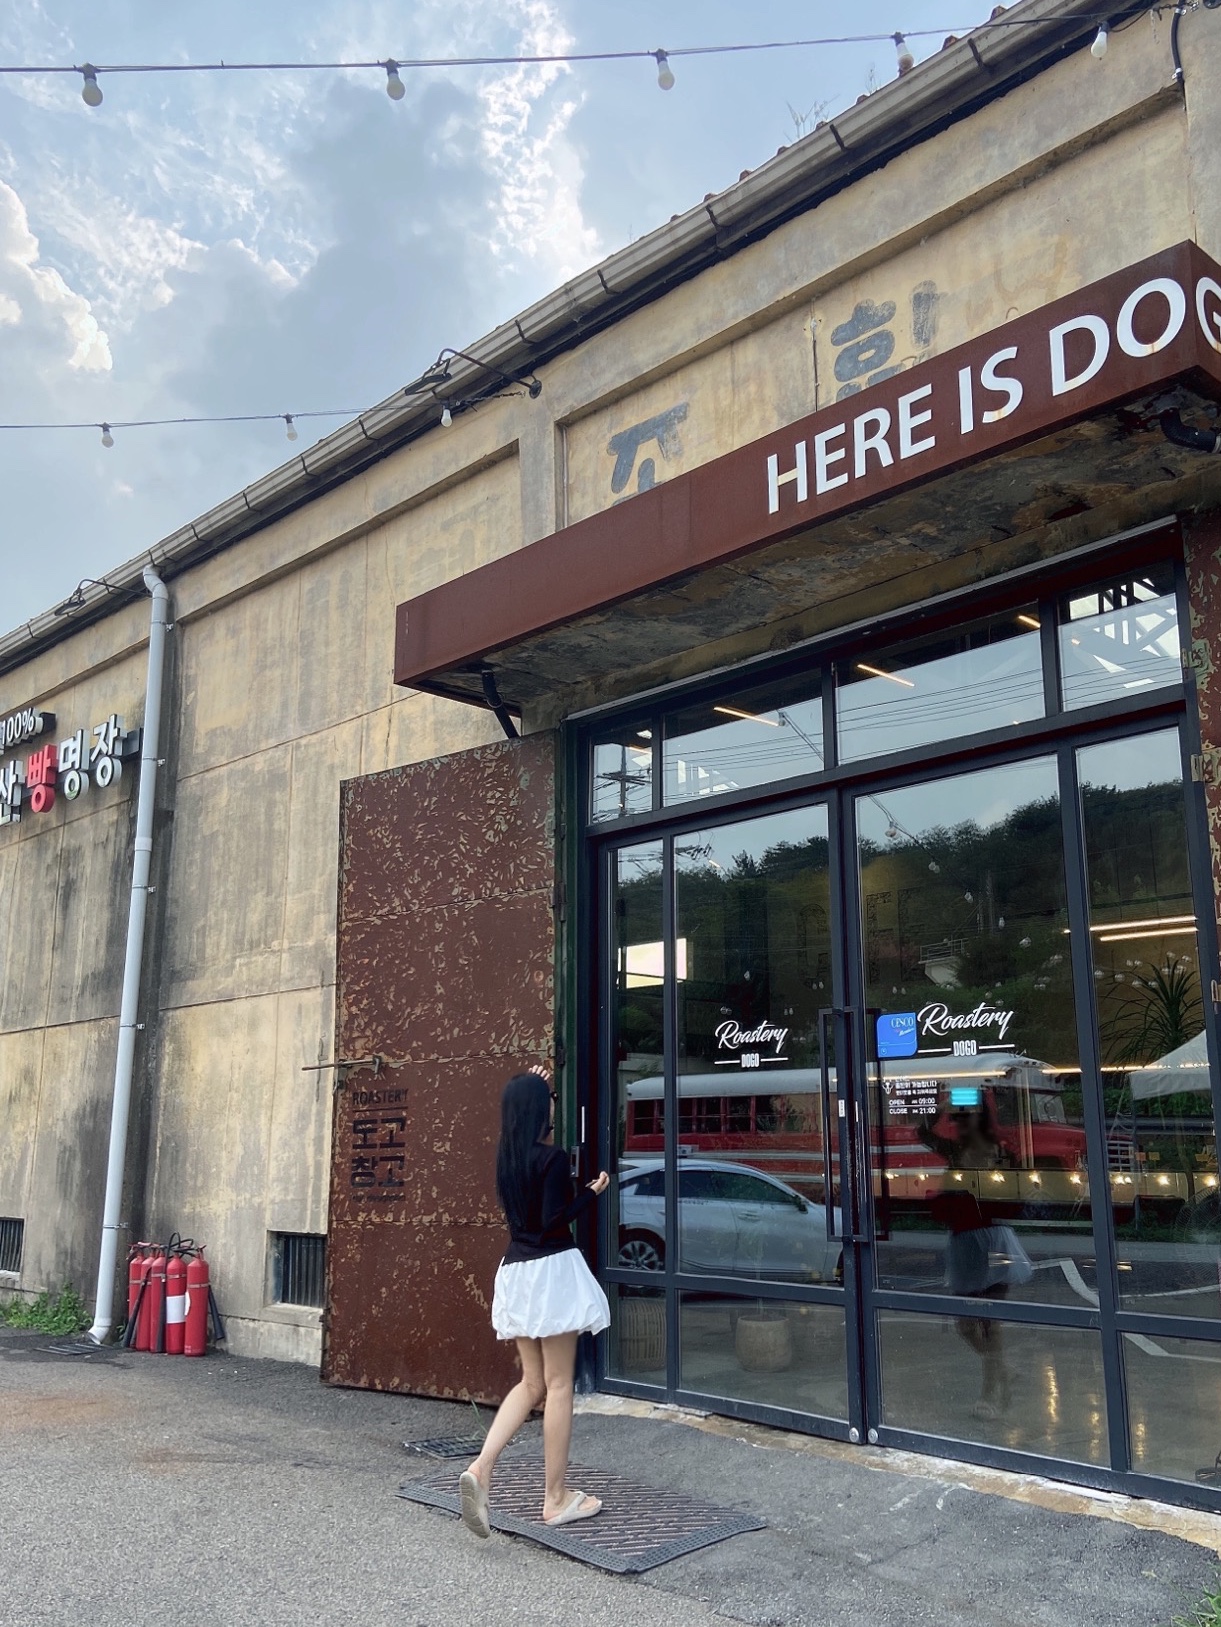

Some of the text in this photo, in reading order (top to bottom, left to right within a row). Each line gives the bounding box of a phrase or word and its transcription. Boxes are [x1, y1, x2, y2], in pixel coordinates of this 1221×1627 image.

[767, 383, 936, 515] HERE
[958, 346, 1023, 435] IS
[1, 707, 36, 746] 100%
[714, 1020, 789, 1054] Roastery
[917, 1001, 1015, 1040] Roastery
[741, 1052, 760, 1069] DOGO
[953, 1039, 978, 1057] DOGO
[352, 1088, 408, 1105] ROASTERY
[352, 1117, 407, 1150] 도고
[351, 1155, 405, 1188] 창고
